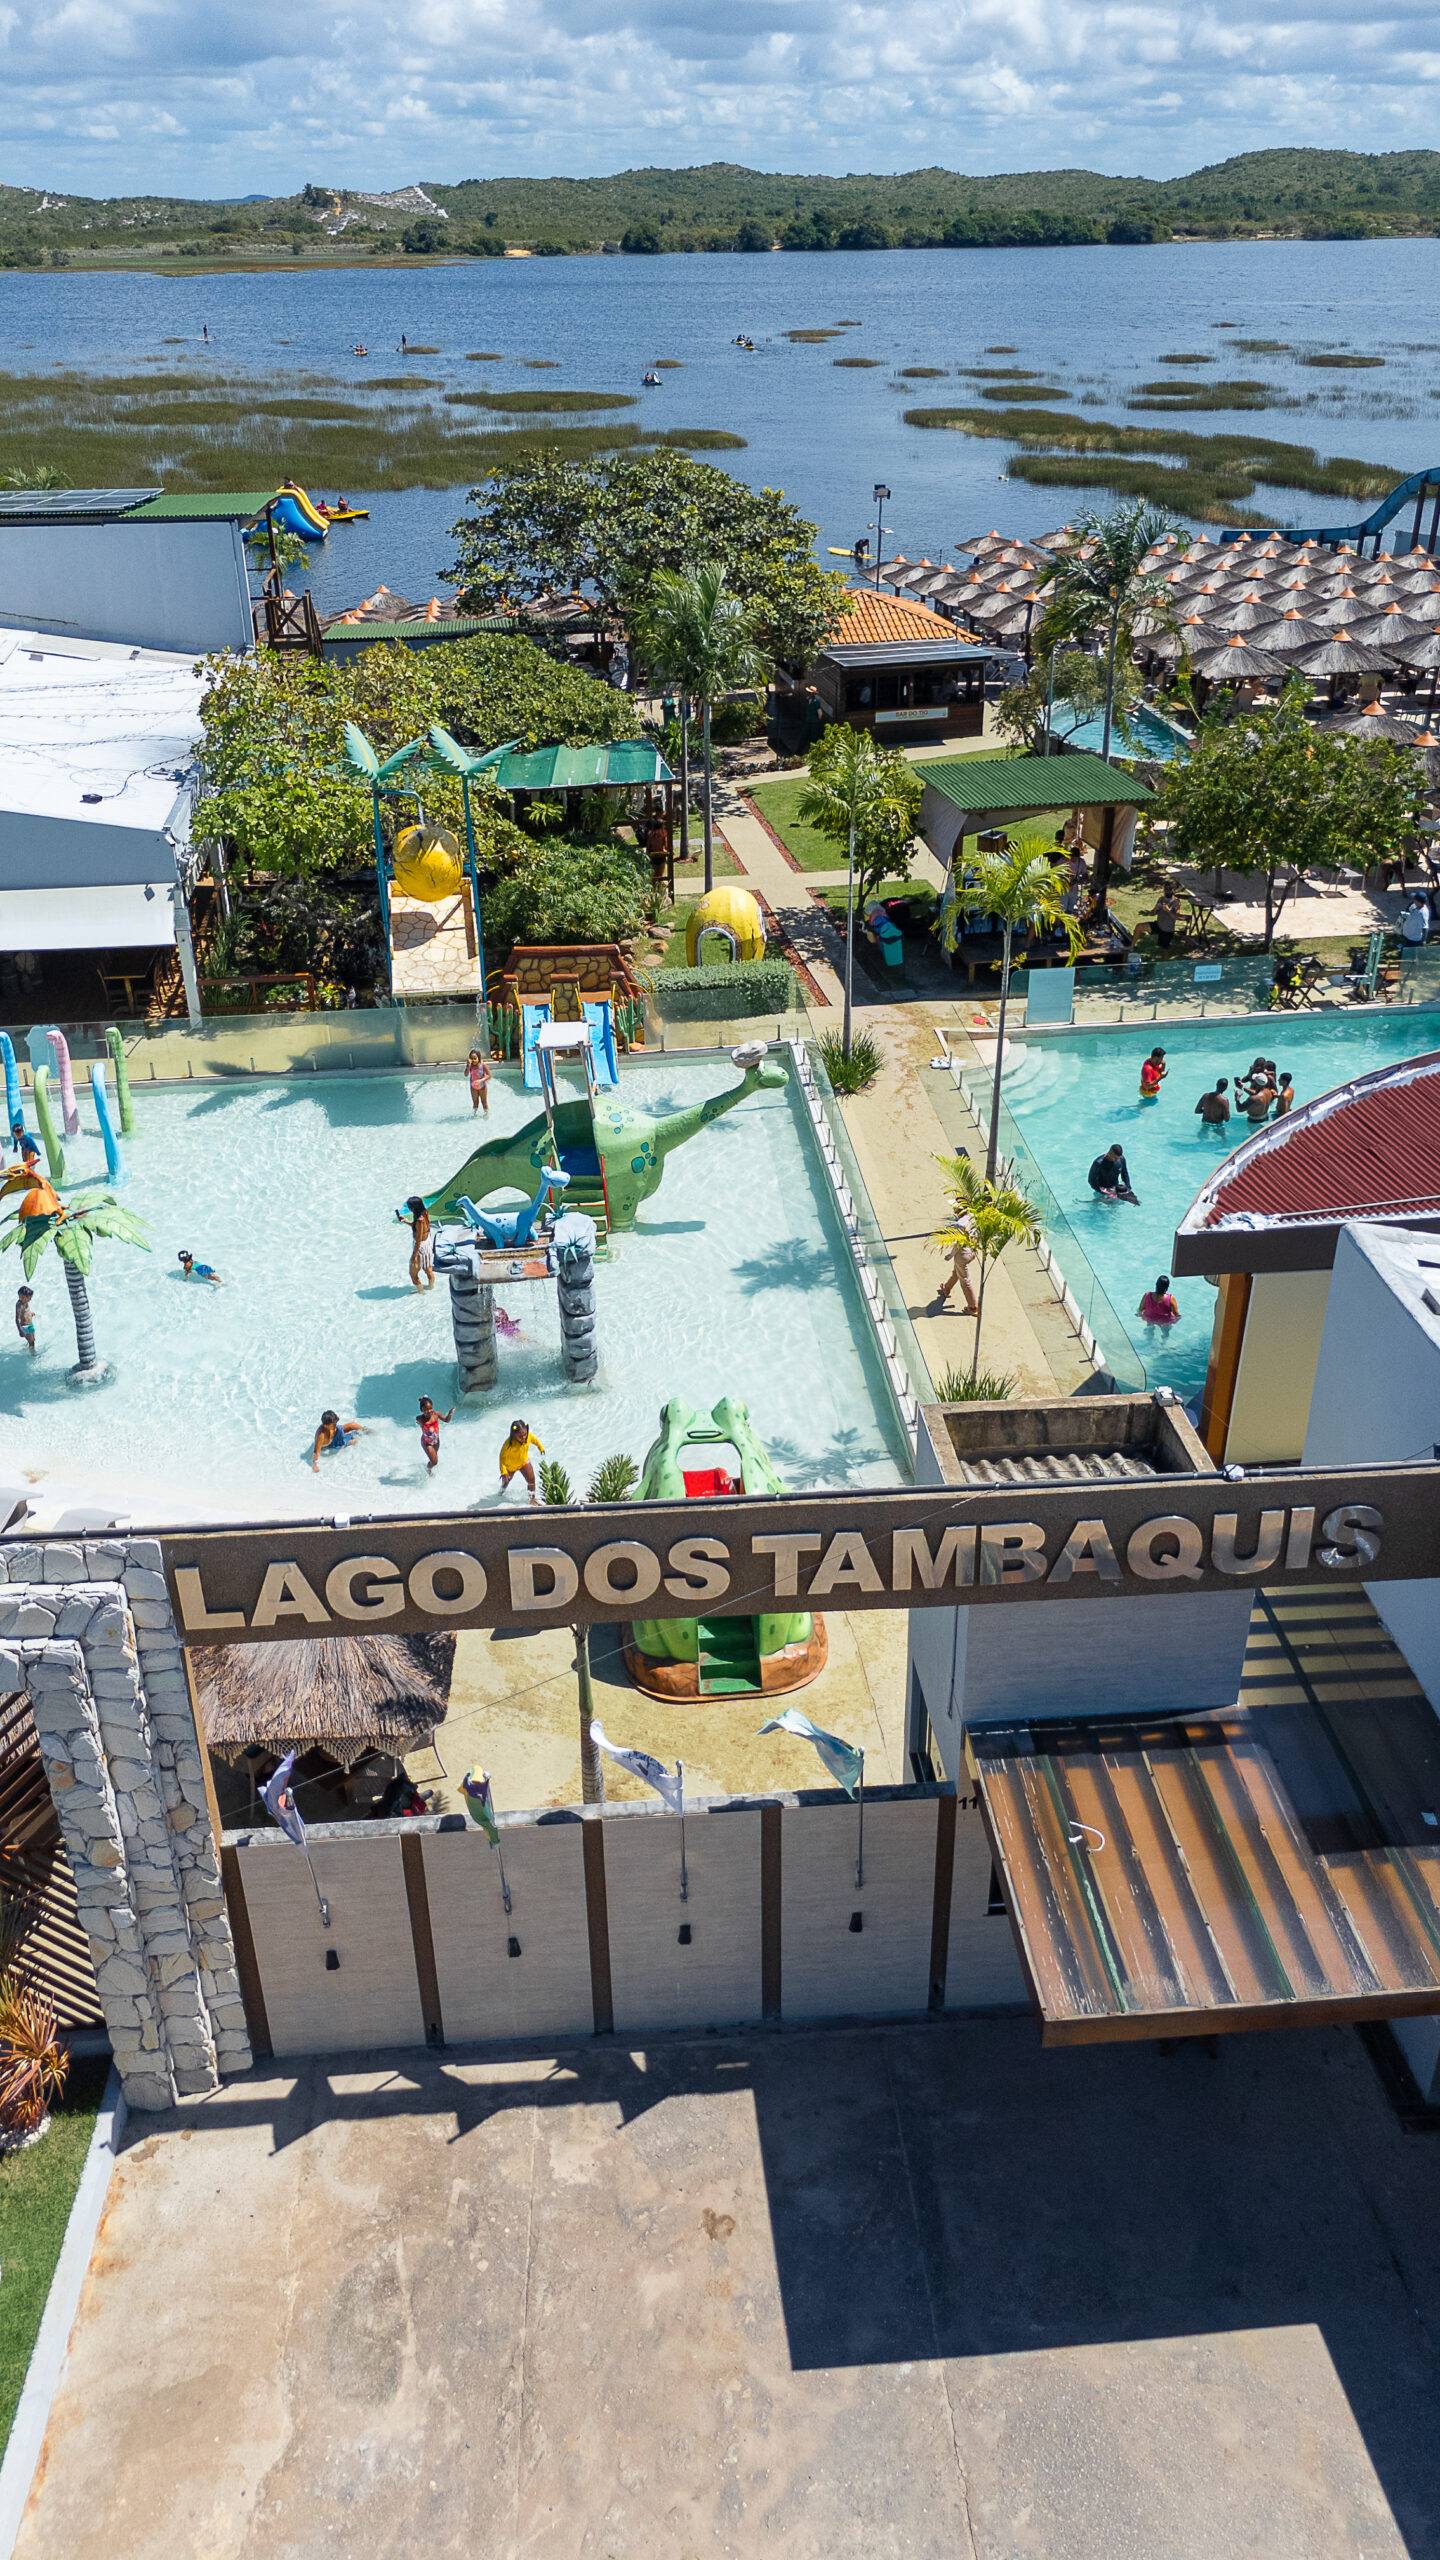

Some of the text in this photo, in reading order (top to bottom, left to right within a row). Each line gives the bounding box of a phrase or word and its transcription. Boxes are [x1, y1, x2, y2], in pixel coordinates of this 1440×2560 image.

[175, 1504, 1384, 1631] LAGO DOS TAMBAQUIS
